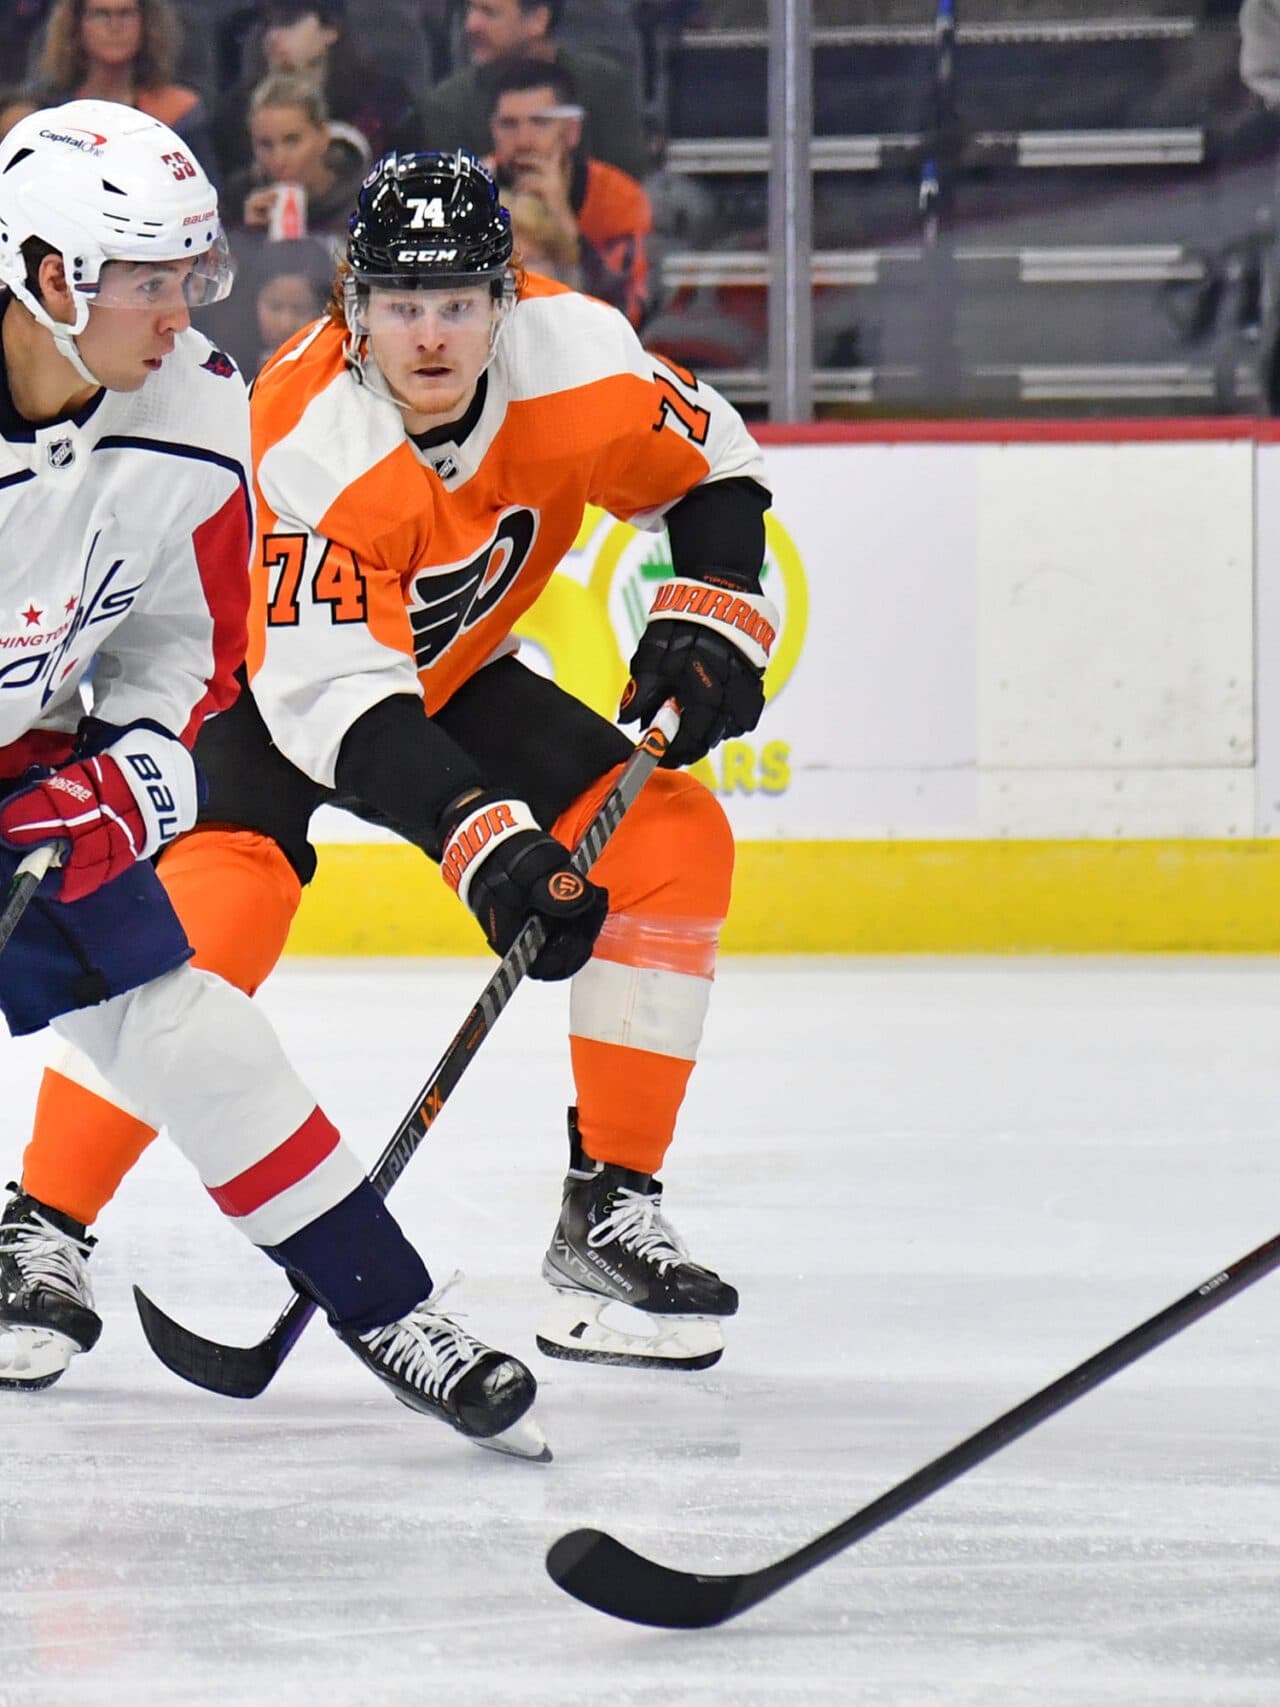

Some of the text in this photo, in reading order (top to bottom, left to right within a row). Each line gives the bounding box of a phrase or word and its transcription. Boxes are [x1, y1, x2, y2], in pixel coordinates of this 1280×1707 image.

[406, 197, 445, 229] 74
[398, 248, 458, 263] CCM
[652, 353, 711, 448] 7
[262, 532, 368, 628] 74
